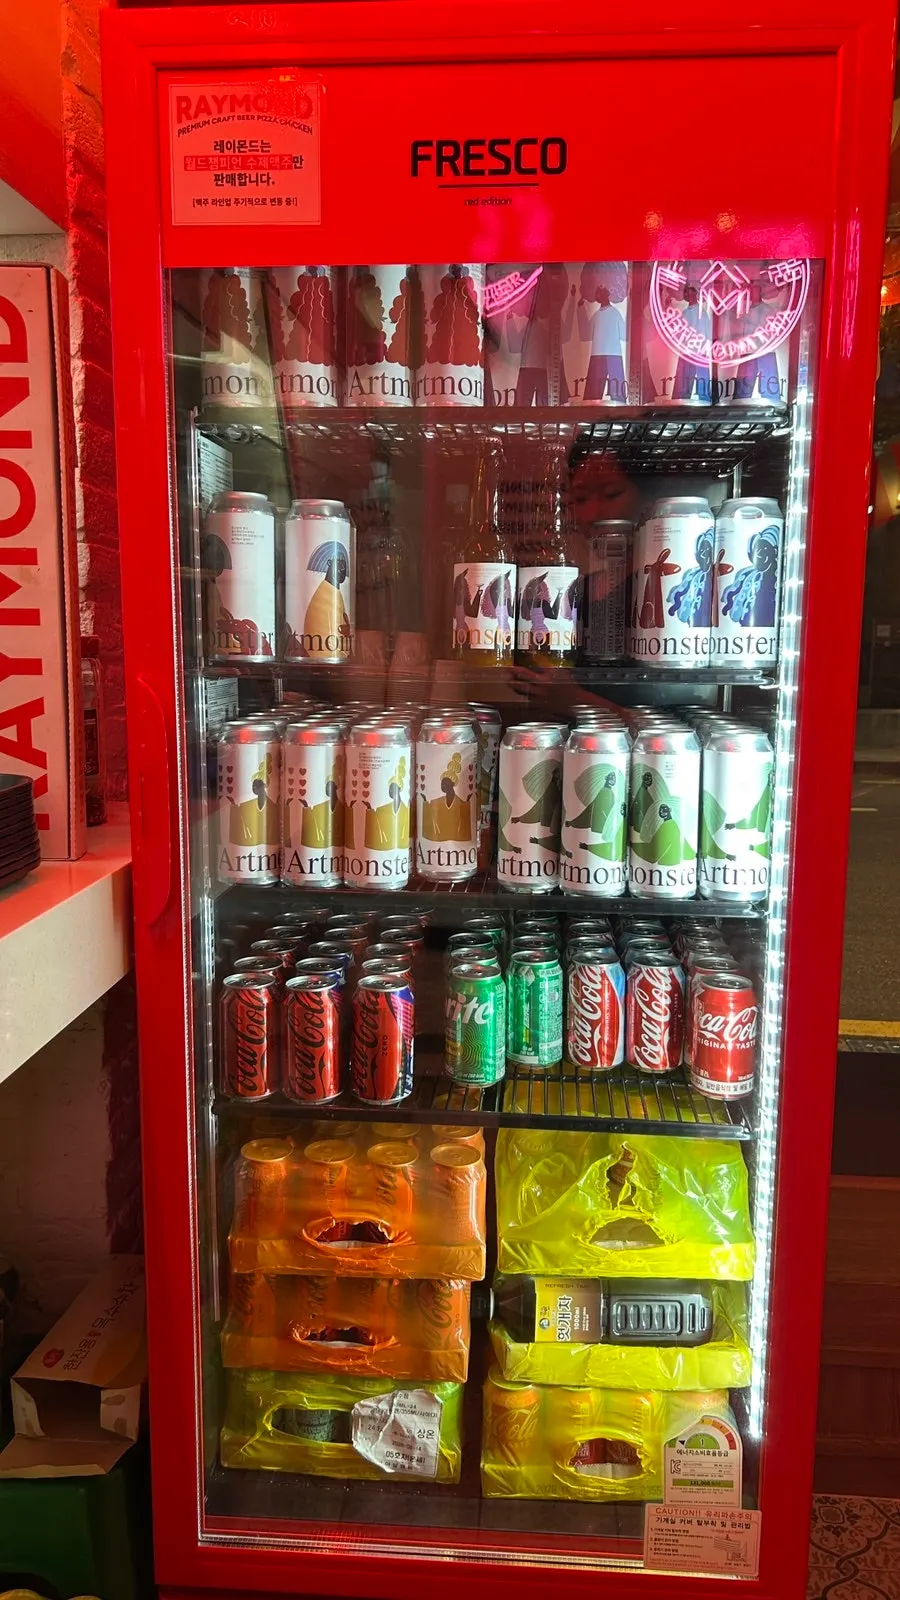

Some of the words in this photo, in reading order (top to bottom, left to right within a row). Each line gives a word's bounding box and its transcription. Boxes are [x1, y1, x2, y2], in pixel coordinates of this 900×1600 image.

[177, 118, 211, 138] PREMIUM
[211, 114, 237, 125] CRAFT
[256, 114, 279, 124] PIZZA
[279, 118, 313, 136] CHICKEN
[213, 140, 272, 154] 레이몬드는
[184, 156, 242, 171] 월드챔피언
[246, 155, 304, 170] 수제맥주만
[410, 137, 567, 177] FRESCO
[213, 172, 276, 187] 판매합니다.
[464, 197, 479, 206] red
[481, 196, 512, 206] edition
[417, 1428, 435, 1440] 상온
[676, 1448, 729, 1458] 에너지소비효율등급
[655, 1507, 701, 1517] CAUTION!!
